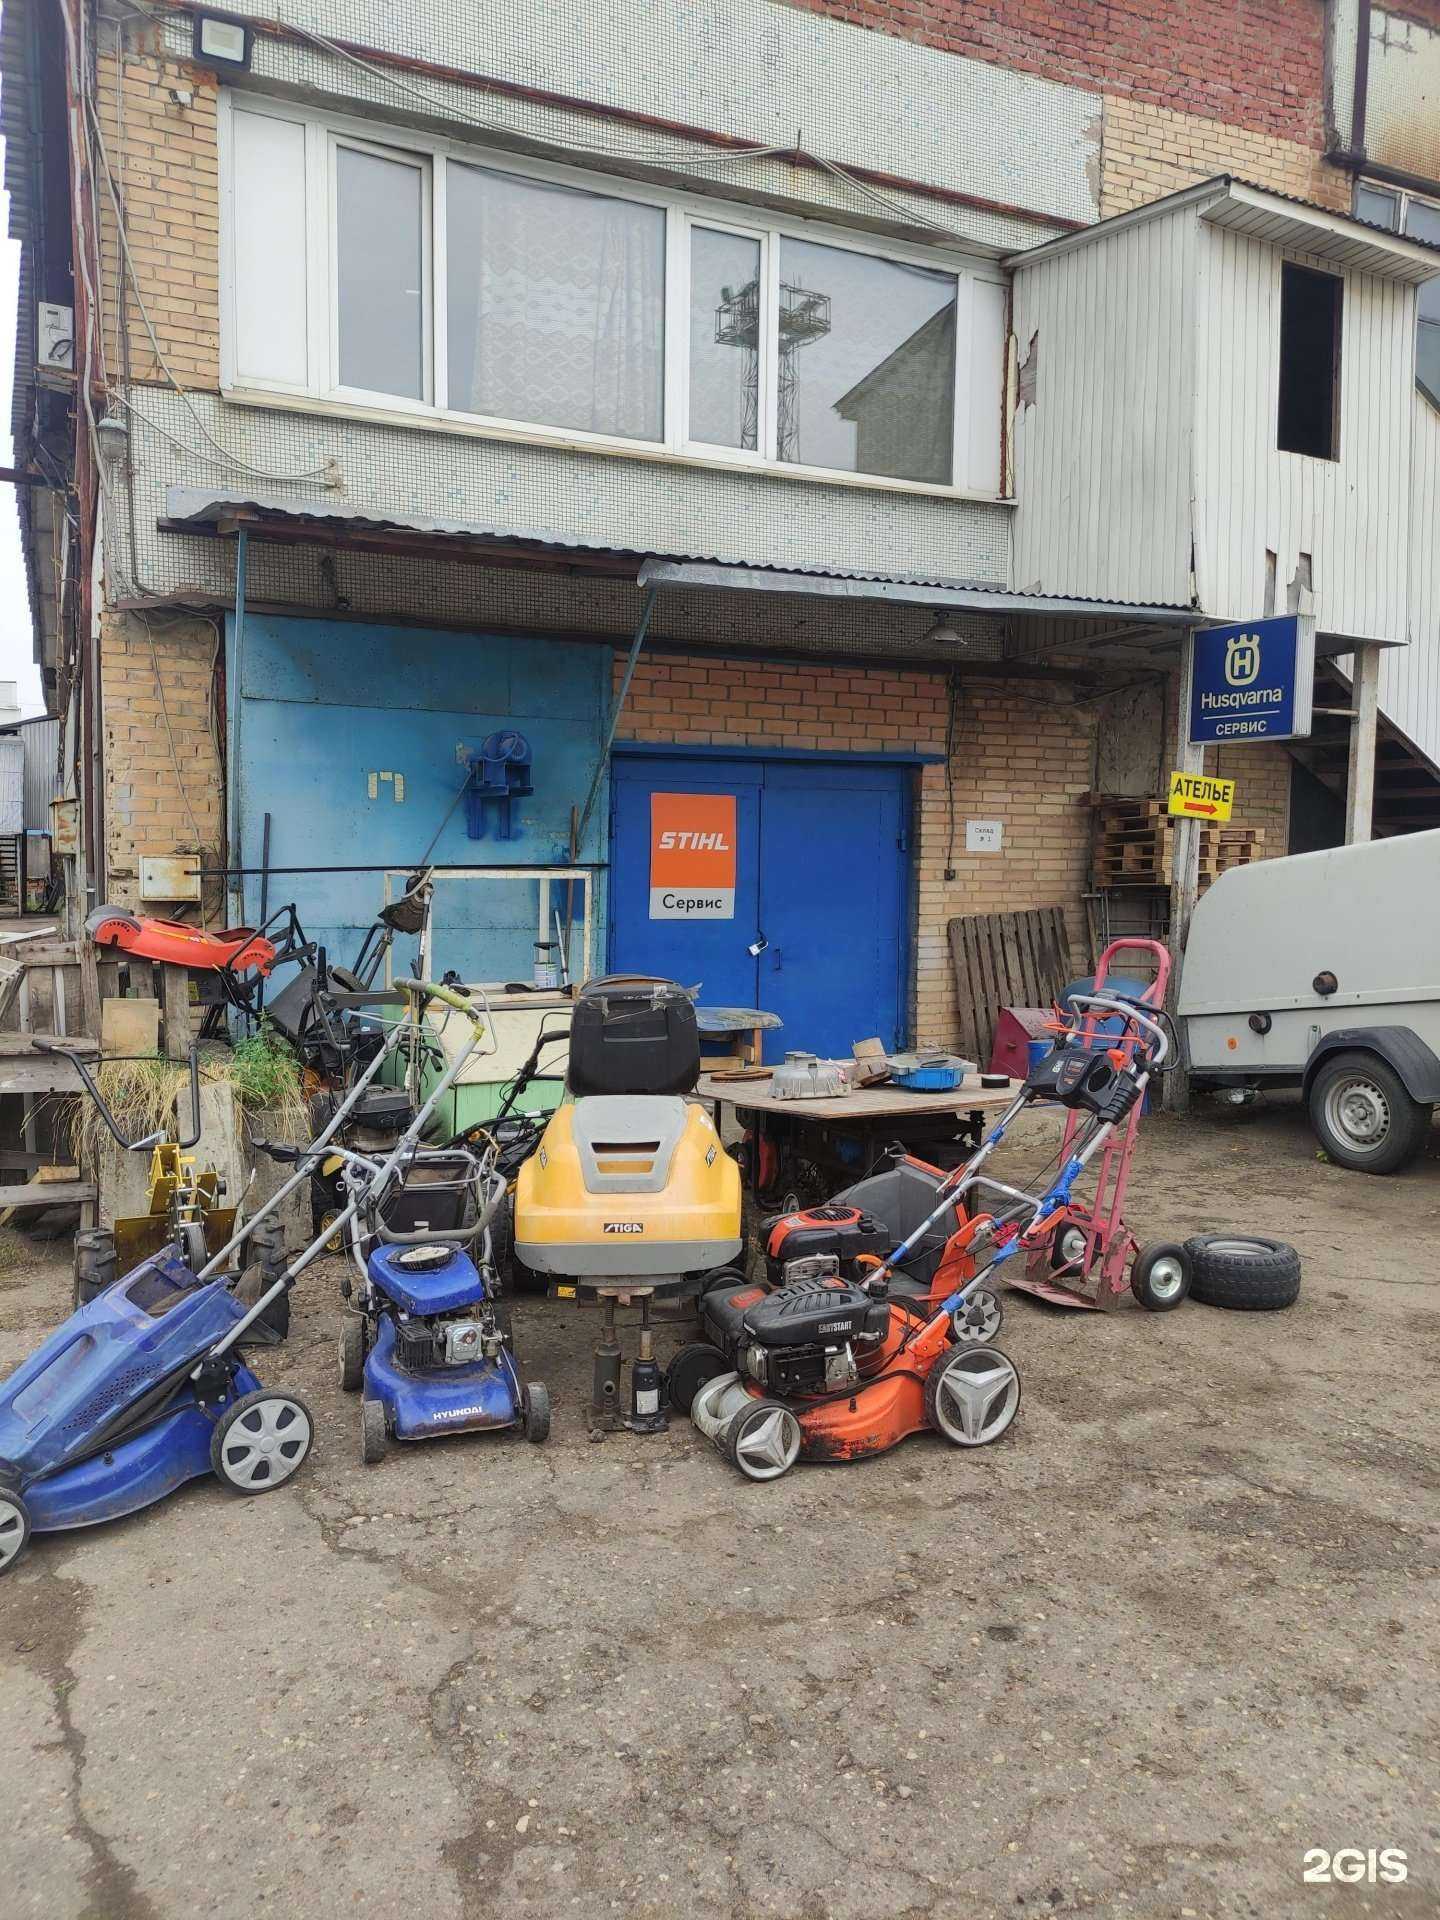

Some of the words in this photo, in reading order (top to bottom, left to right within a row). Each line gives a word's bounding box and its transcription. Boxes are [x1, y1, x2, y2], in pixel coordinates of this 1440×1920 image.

[1201, 687, 1283, 709] Husqvarna
[1215, 720, 1267, 736] СЕРВИС
[1173, 777, 1231, 803] АТЕЛЬЕ
[658, 831, 730, 851] STIHL
[662, 893, 723, 913] Сервис
[604, 1223, 643, 1233] STIGA
[433, 1406, 482, 1420] HYUNDAI
